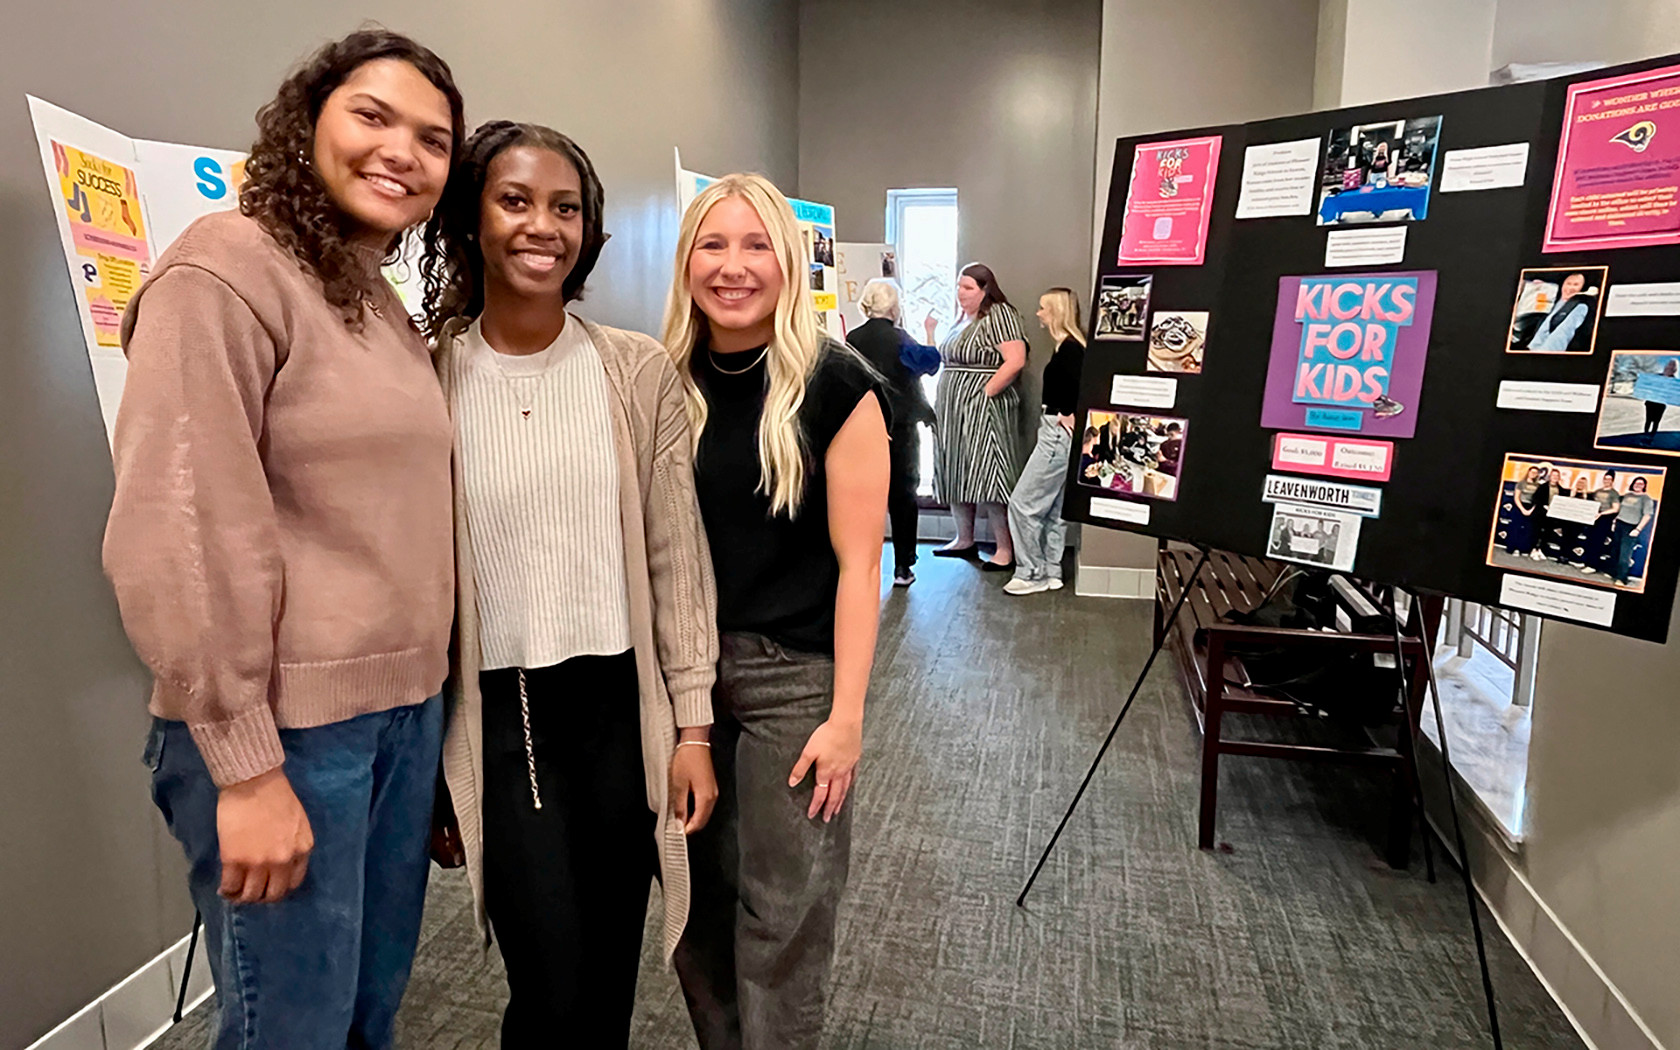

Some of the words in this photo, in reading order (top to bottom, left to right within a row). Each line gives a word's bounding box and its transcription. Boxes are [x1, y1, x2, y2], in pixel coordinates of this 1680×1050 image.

[1157, 147, 1189, 160] KICKS
[1160, 158, 1182, 168] FOR
[77, 168, 122, 198] SUCCESS
[1295, 283, 1416, 323] KICKS
[1304, 322, 1387, 361] FOR
[1296, 362, 1388, 403] KIDS
[1267, 479, 1350, 504] LEAVENWORTH
